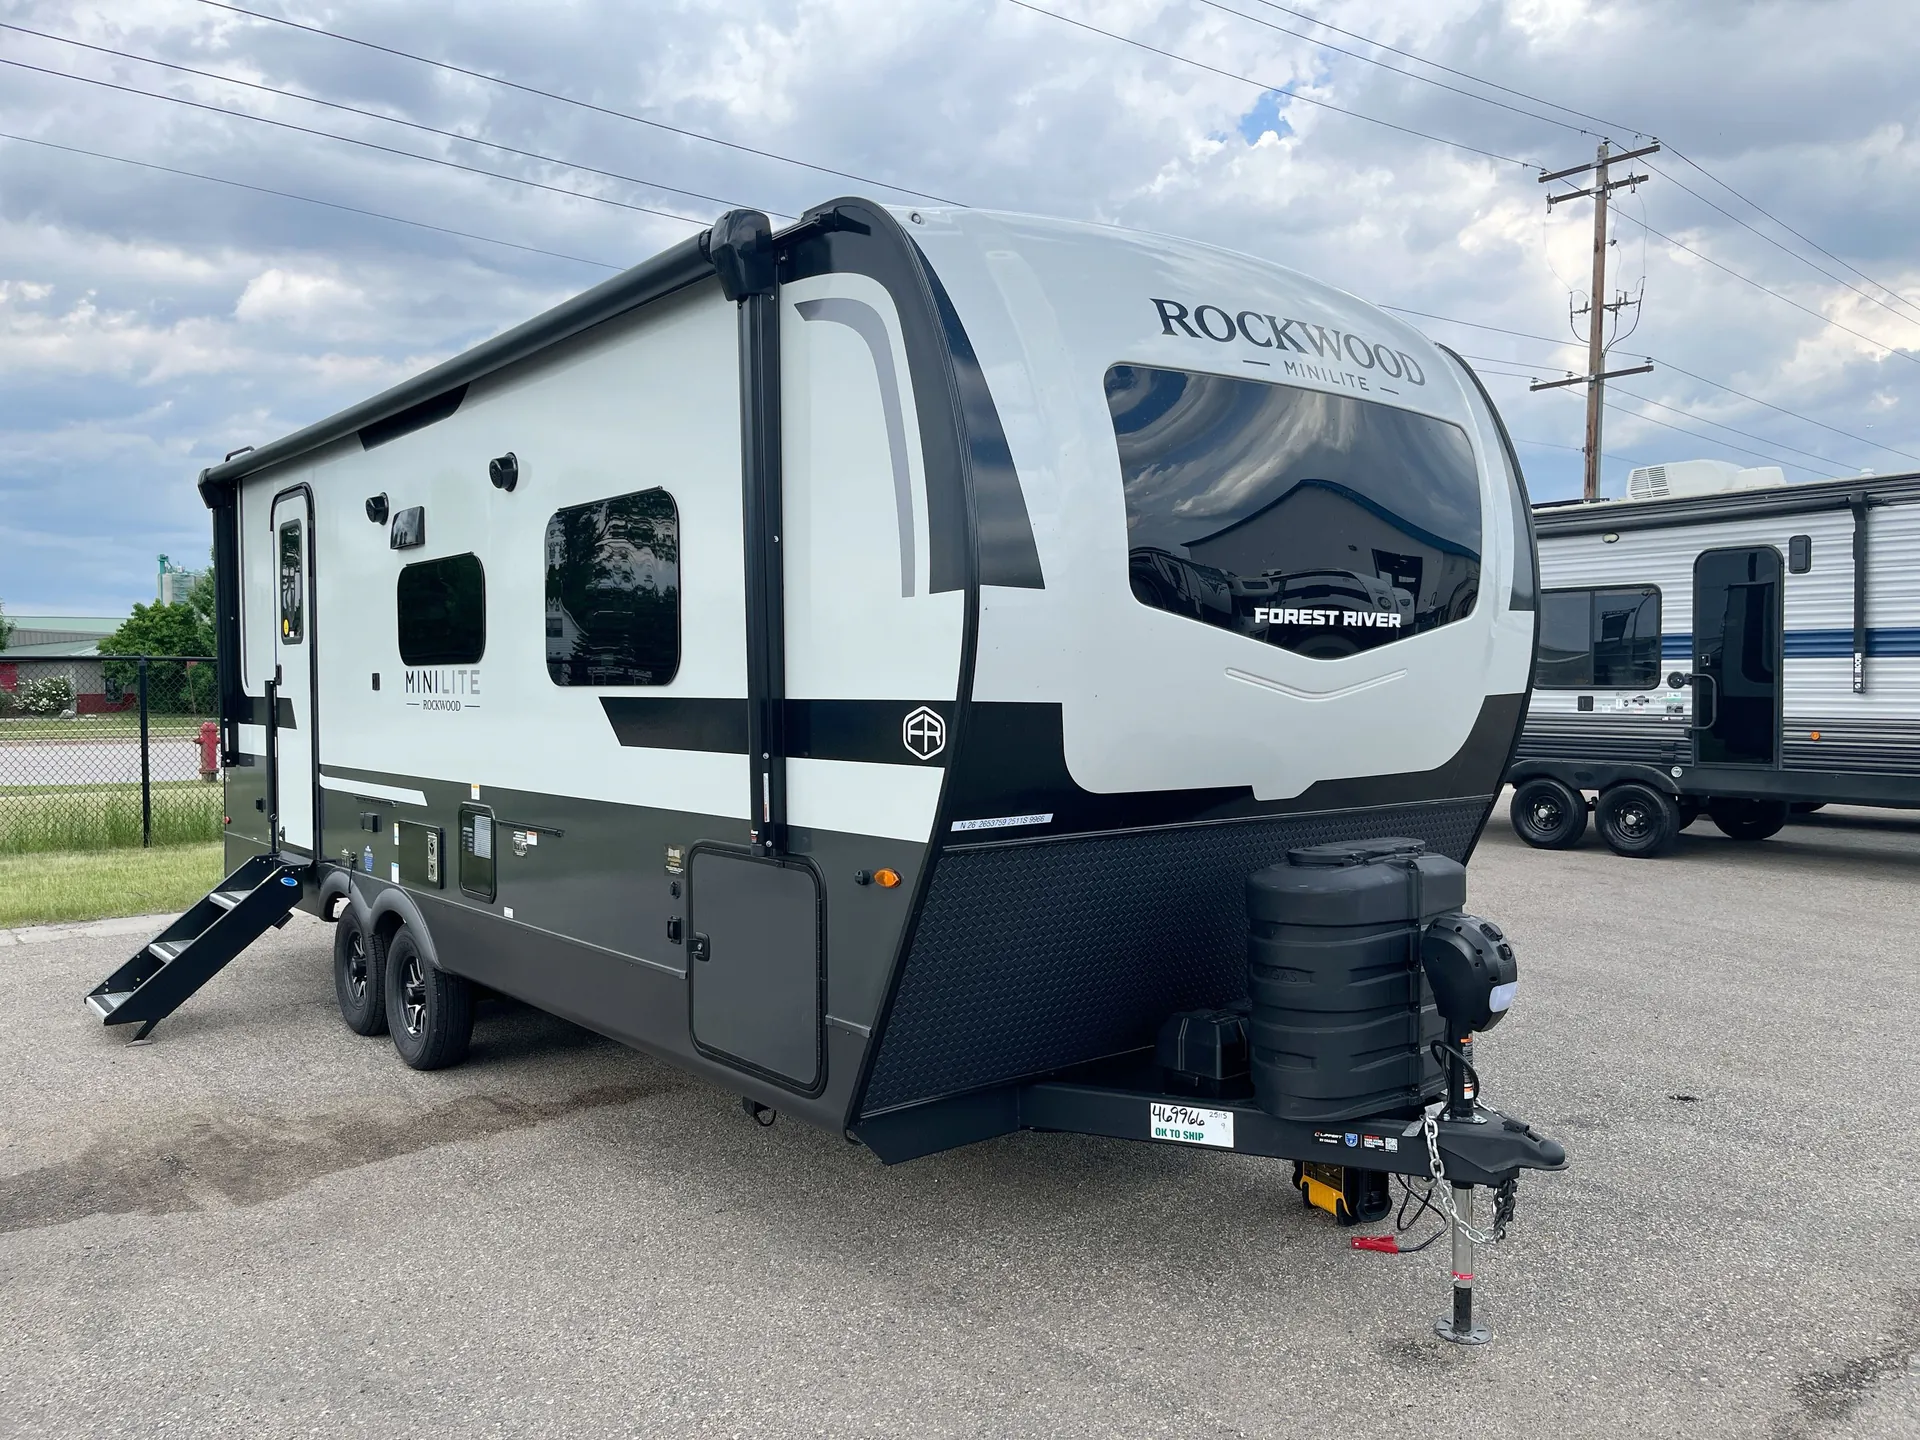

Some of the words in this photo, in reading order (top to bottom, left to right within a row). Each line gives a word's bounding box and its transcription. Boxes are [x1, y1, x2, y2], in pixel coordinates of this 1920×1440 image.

[1149, 298, 1426, 386] ROCKWOOD
[1284, 360, 1370, 392] MINILITE
[1254, 607, 1339, 626] FOREST
[1343, 611, 1401, 628] RIVER
[405, 670, 481, 695] MINILITE
[423, 699, 461, 712] ROCKWOOD
[960, 821, 966, 829] N
[1152, 1104, 1205, 1126] 469966
[1155, 1127, 1167, 1137] OK
[1169, 1128, 1181, 1139] TO
[1183, 1130, 1204, 1141] SHIP
